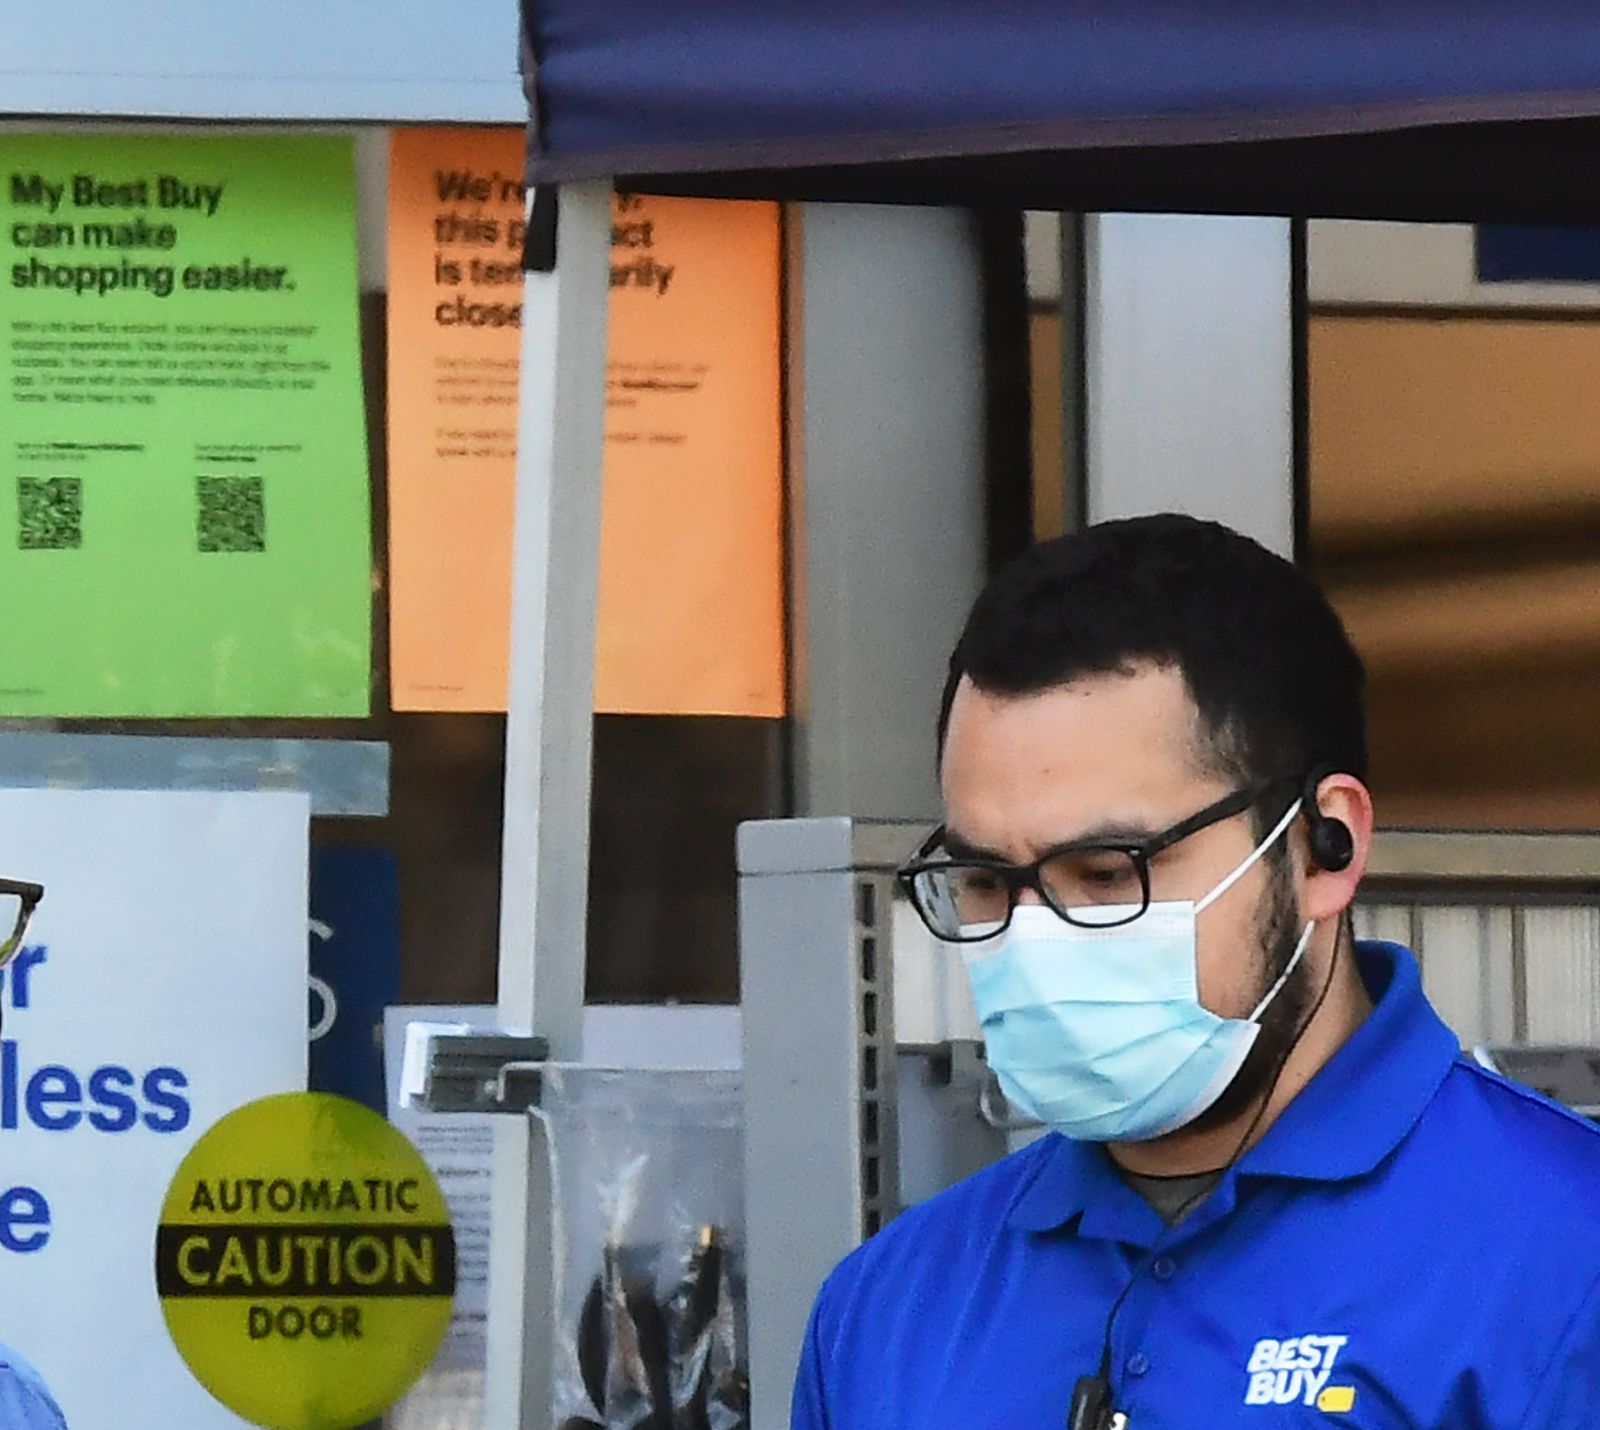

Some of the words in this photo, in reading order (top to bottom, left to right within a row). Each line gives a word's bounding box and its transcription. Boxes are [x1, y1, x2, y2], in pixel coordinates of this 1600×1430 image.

[9, 173, 64, 213] My
[72, 176, 147, 208] Best
[159, 178, 225, 217] Buy
[11, 222, 75, 250] can
[83, 218, 176, 251] make
[435, 213, 498, 244] this
[11, 259, 174, 298] shopping
[182, 262, 297, 292] easier.
[435, 252, 462, 286] is
[436, 293, 522, 329] close
[190, 1179, 419, 1212] AUTOMATIC
[177, 1235, 434, 1286] CAUTION
[247, 1306, 361, 1340] DOOR
[1247, 1334, 1349, 1373] BEST
[1244, 1368, 1331, 1406] BUY
